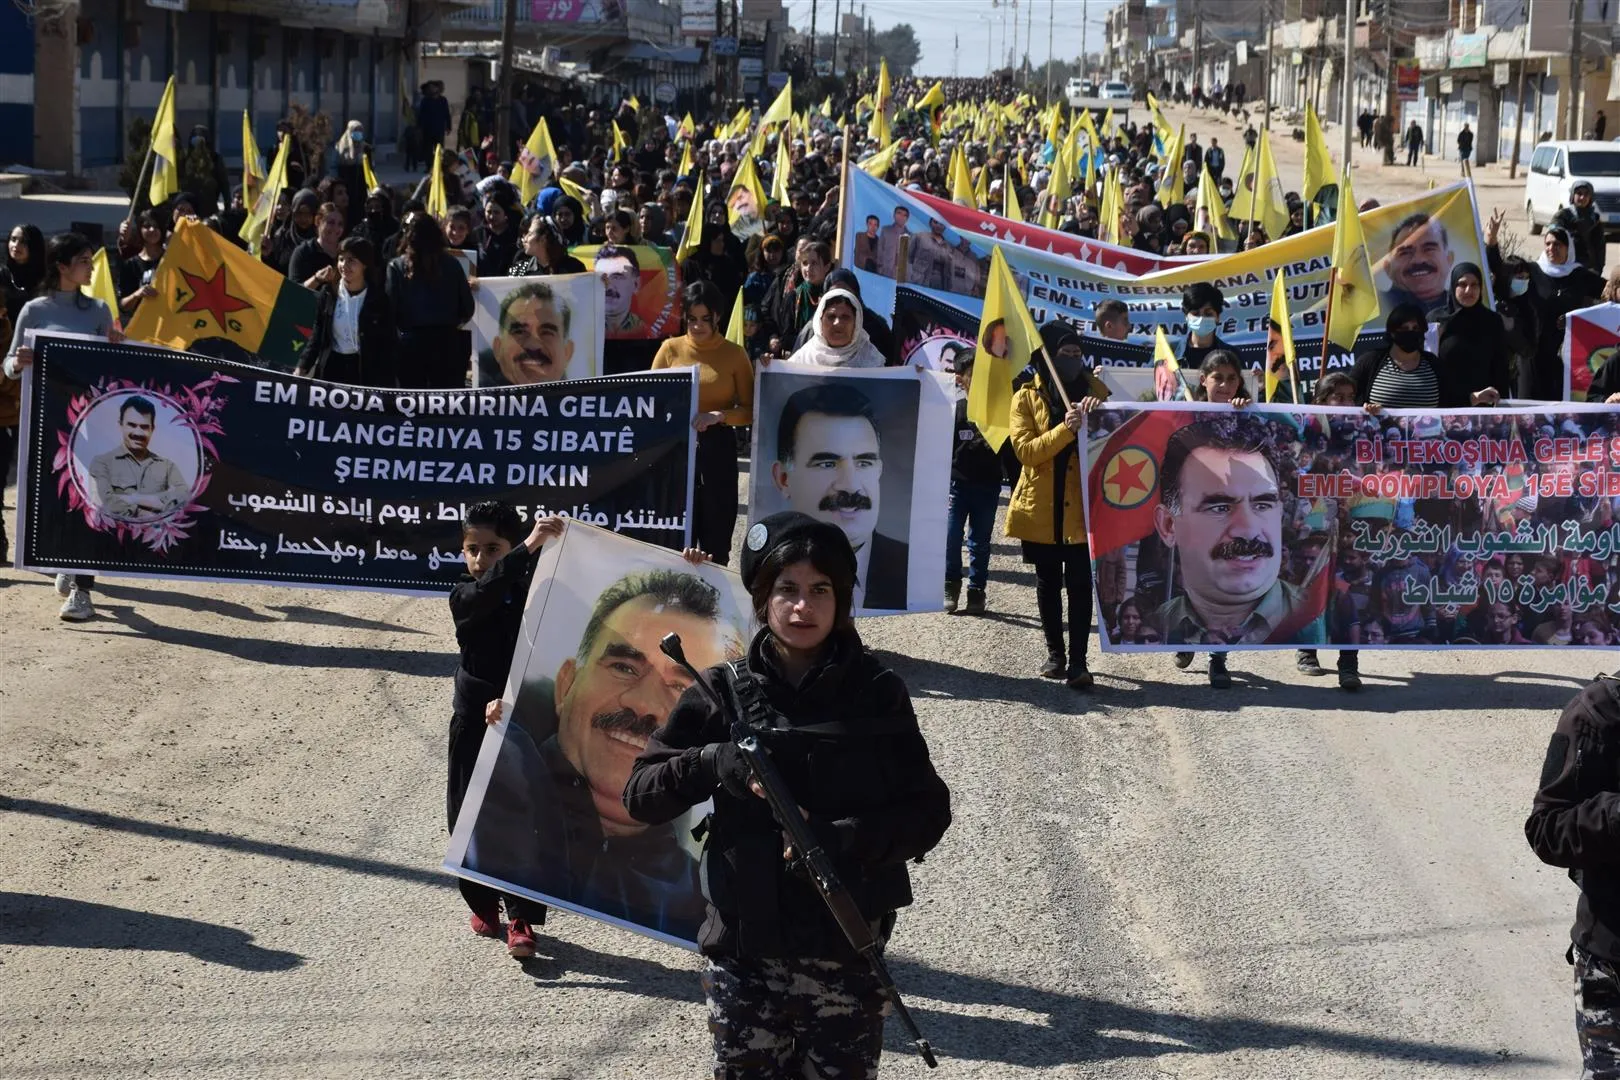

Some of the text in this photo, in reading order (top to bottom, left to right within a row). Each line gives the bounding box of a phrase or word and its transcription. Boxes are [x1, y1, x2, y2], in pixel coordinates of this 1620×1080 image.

[254, 381, 298, 405] EM
[308, 385, 385, 412] ROJA
[395, 394, 549, 418] QIRKIRINA
[559, 395, 655, 418] GELAN
[287, 418, 636, 453] PILANGÊRIYA 15 SIBATÊ
[1389, 434, 1529, 469] TEKOŞÎNA
[1534, 432, 1604, 463] GELÊ
[334, 456, 589, 487] ŞERMEZAR DIKIN
[1298, 468, 1354, 498] EMÊ
[1361, 474, 1511, 499] QOMPLOYA
[1525, 467, 1574, 498] 15Ê
[228, 490, 316, 513] الشعوب
[322, 495, 373, 523] إبادة
[378, 506, 421, 525] يوم
[1351, 519, 1450, 563] الثورية
[1456, 519, 1558, 561] الشعوب
[1402, 570, 1607, 613] مؤامرة ١٥ شباط
